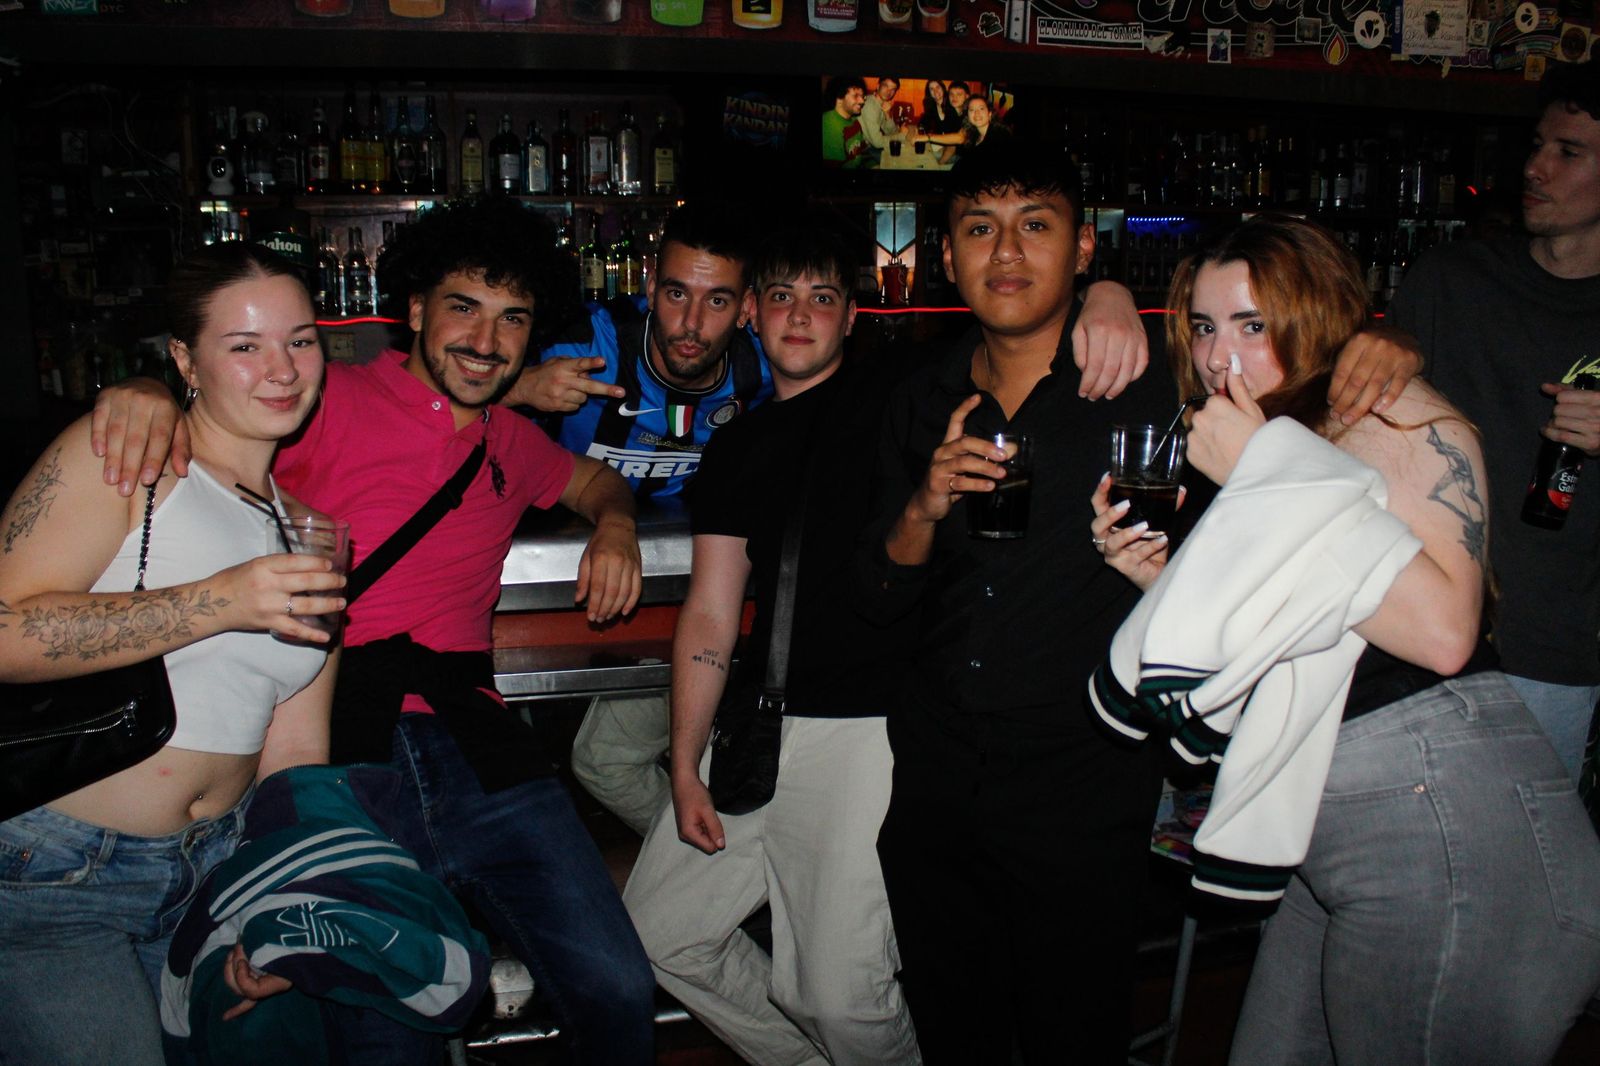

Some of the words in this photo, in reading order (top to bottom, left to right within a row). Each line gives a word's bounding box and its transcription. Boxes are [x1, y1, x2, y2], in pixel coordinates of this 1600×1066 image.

[1040, 20, 1050, 35] EL
[1052, 21, 1089, 38] ORGULLO
[1091, 24, 1107, 39] DEL
[1109, 26, 1142, 40] TORMES
[724, 96, 790, 119] KINDIN
[256, 237, 302, 254] ahou
